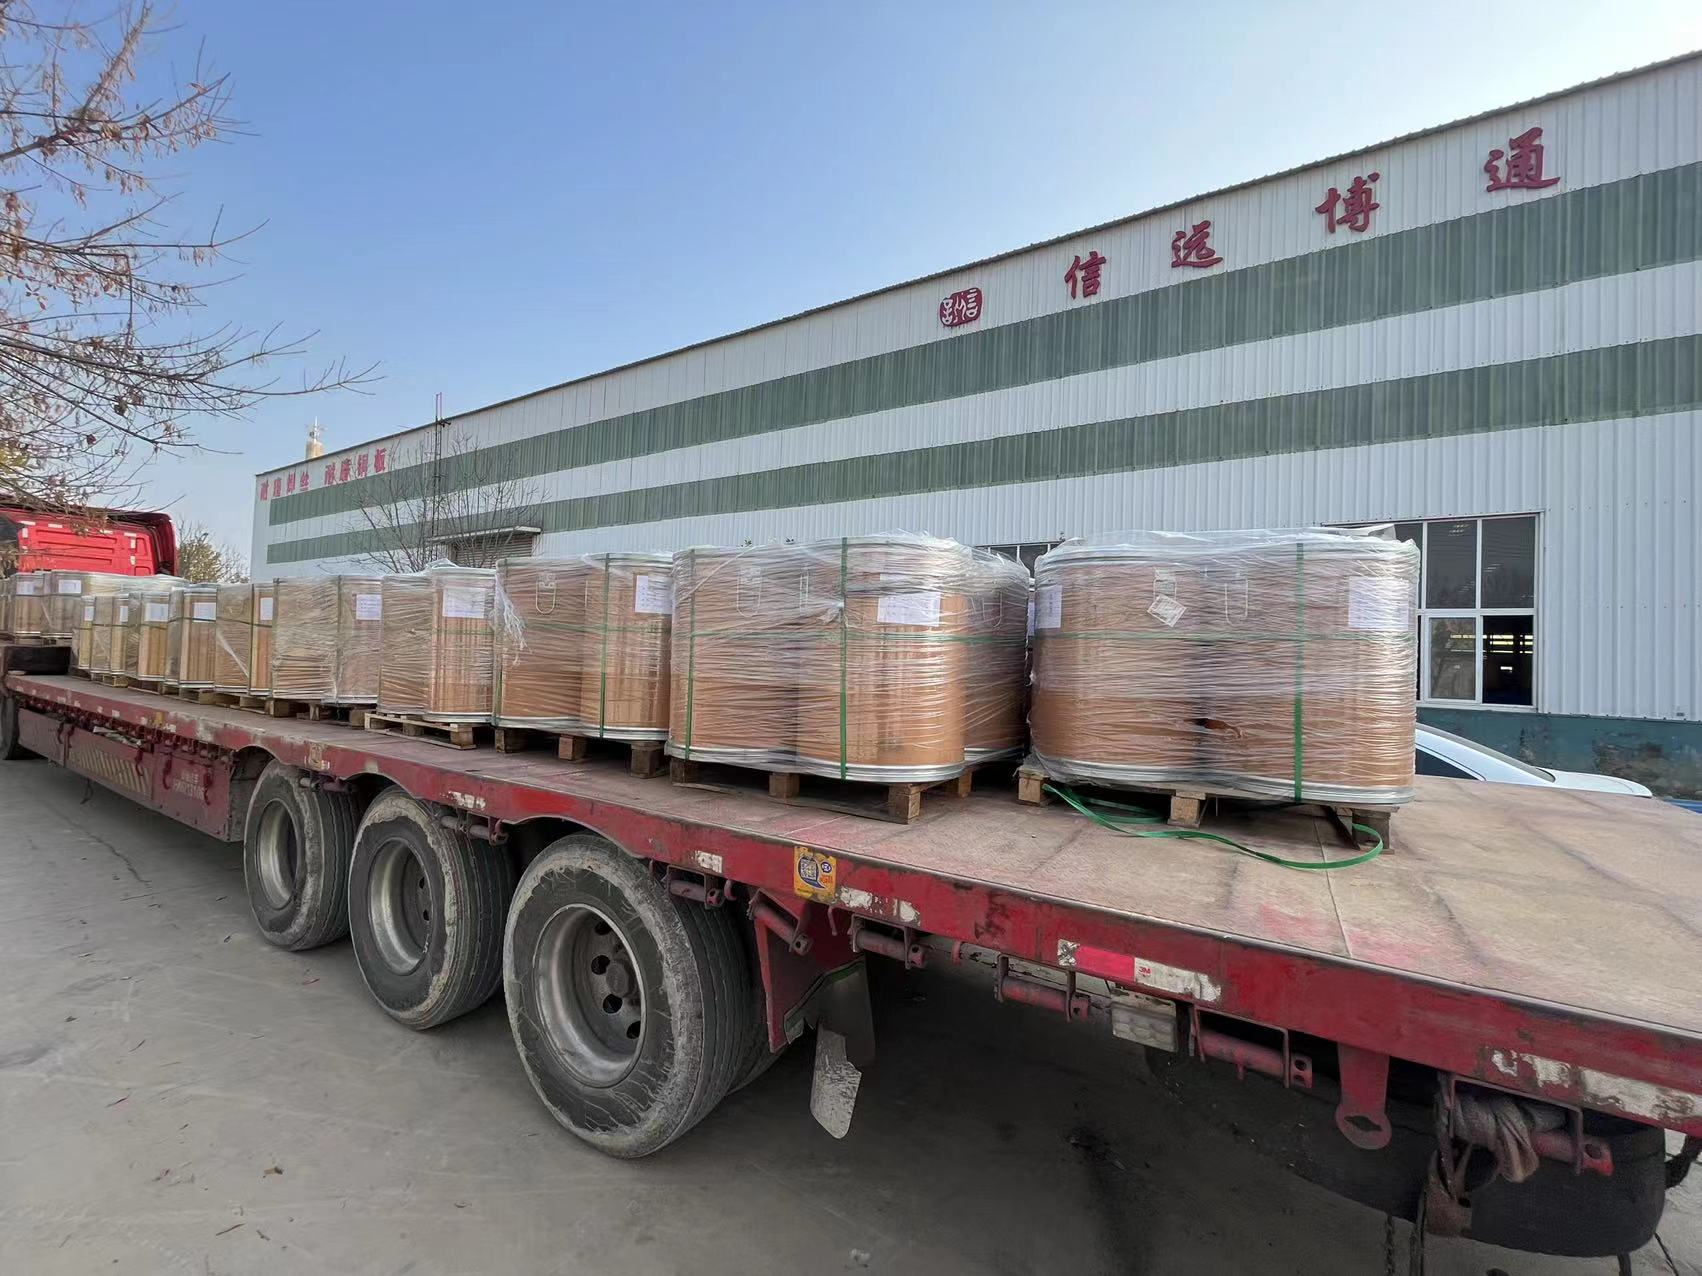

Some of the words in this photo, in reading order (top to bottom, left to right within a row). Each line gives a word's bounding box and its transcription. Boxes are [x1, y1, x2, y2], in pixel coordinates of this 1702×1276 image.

[1065, 127, 1561, 299] 信远博通
[1138, 966, 1152, 975] 3M
